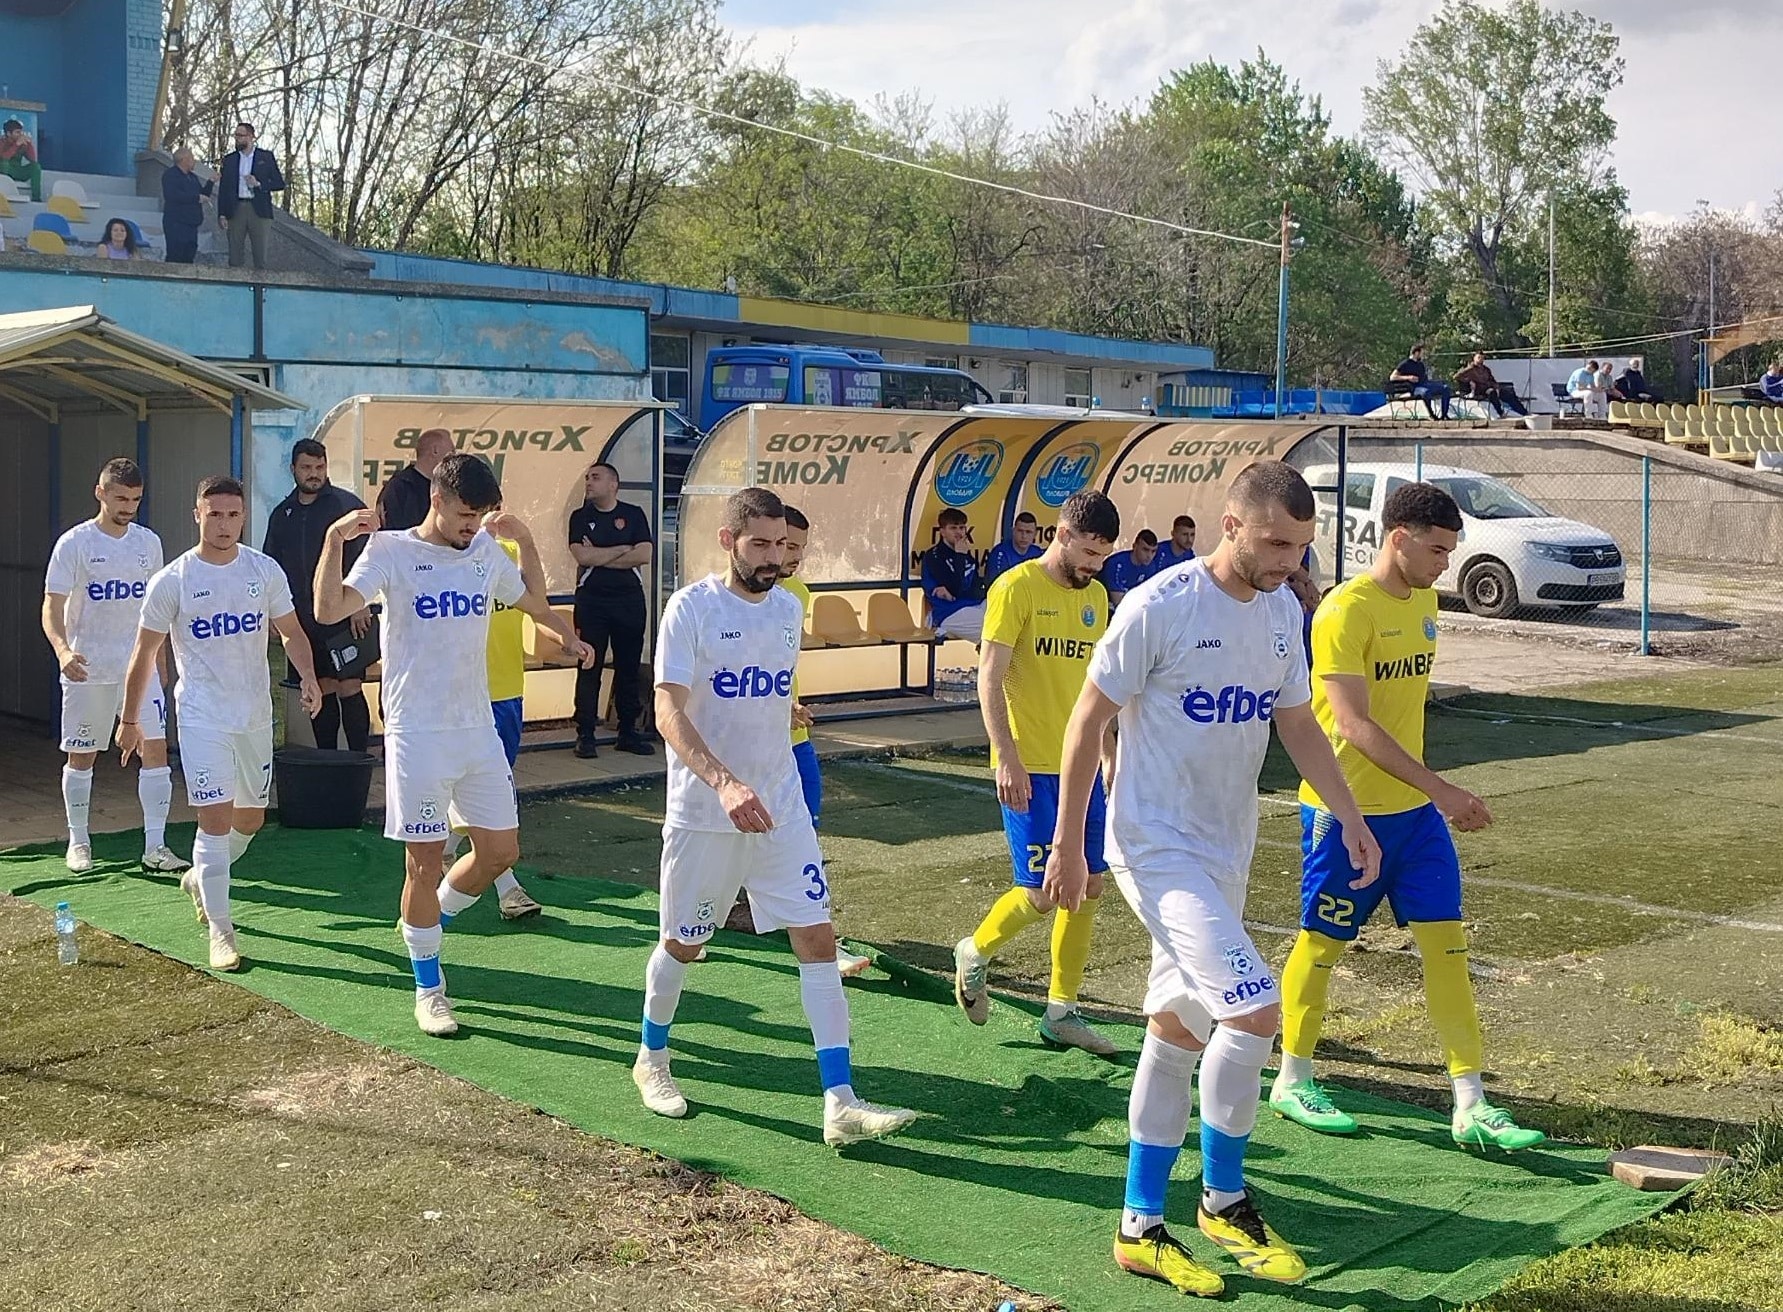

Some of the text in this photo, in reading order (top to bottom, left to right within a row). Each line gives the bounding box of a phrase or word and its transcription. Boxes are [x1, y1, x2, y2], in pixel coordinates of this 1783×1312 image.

[720, 631, 742, 640] JAKO
[1196, 639, 1222, 649] JAKO
[1375, 652, 1434, 681] WINBE
[405, 822, 446, 834] efbet
[1318, 893, 1354, 927] 22
[679, 923, 716, 937] efbe
[1223, 975, 1276, 1005] efbe
